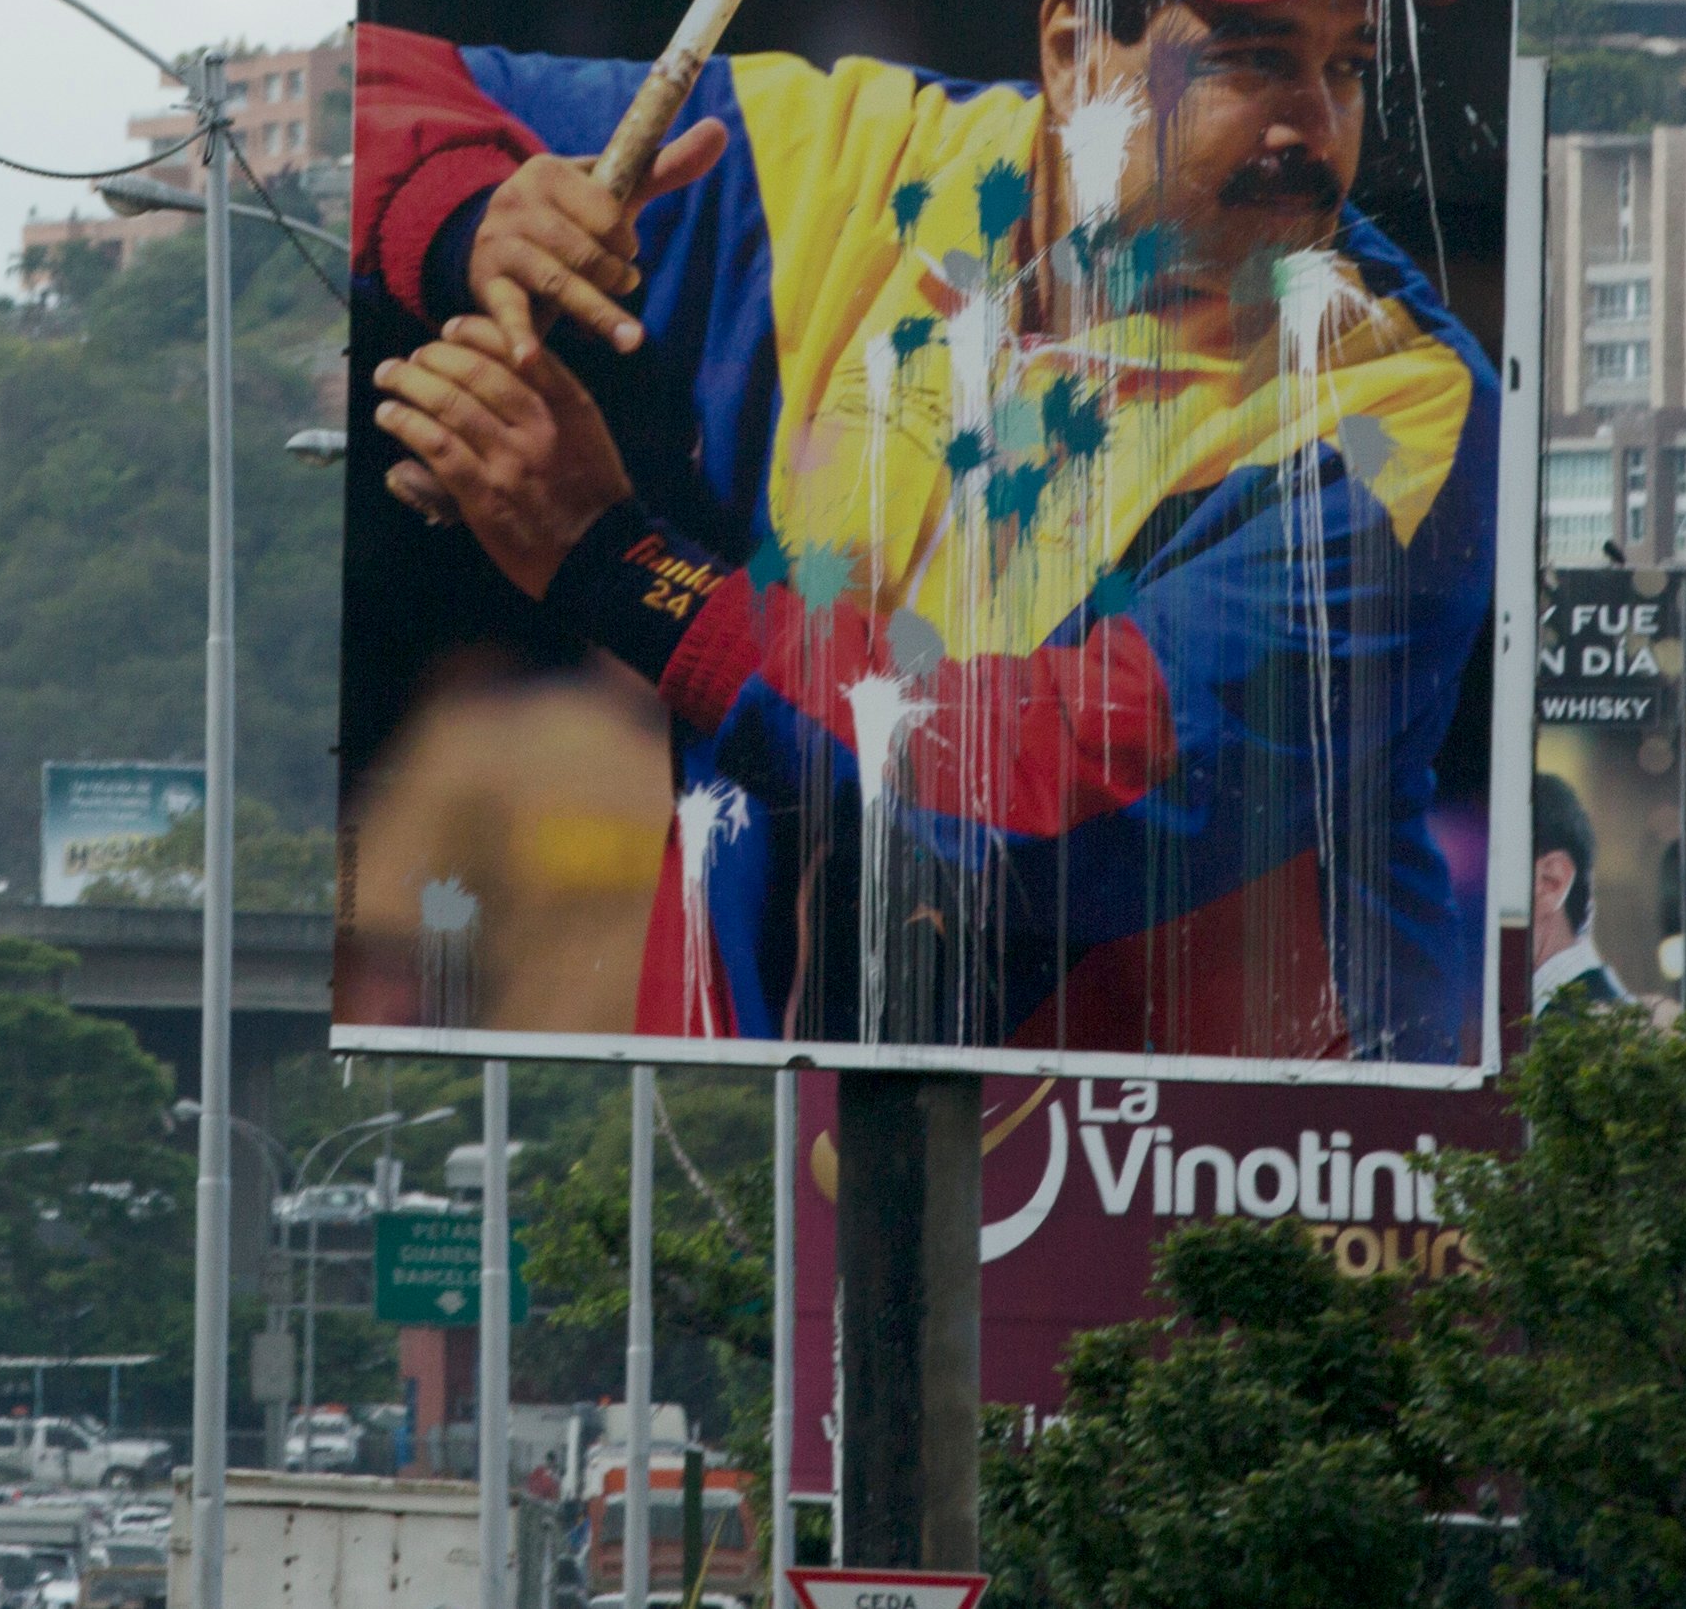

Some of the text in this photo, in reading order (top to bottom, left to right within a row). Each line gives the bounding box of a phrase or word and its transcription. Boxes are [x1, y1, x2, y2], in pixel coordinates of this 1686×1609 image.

[641, 577, 693, 621] 24
[1571, 604, 1659, 636] FUE
[1581, 637, 1659, 677] DÍA
[1542, 696, 1652, 721] WHISKY
[1078, 1079, 1159, 1123] La
[856, 1593, 916, 1609] CEDA
